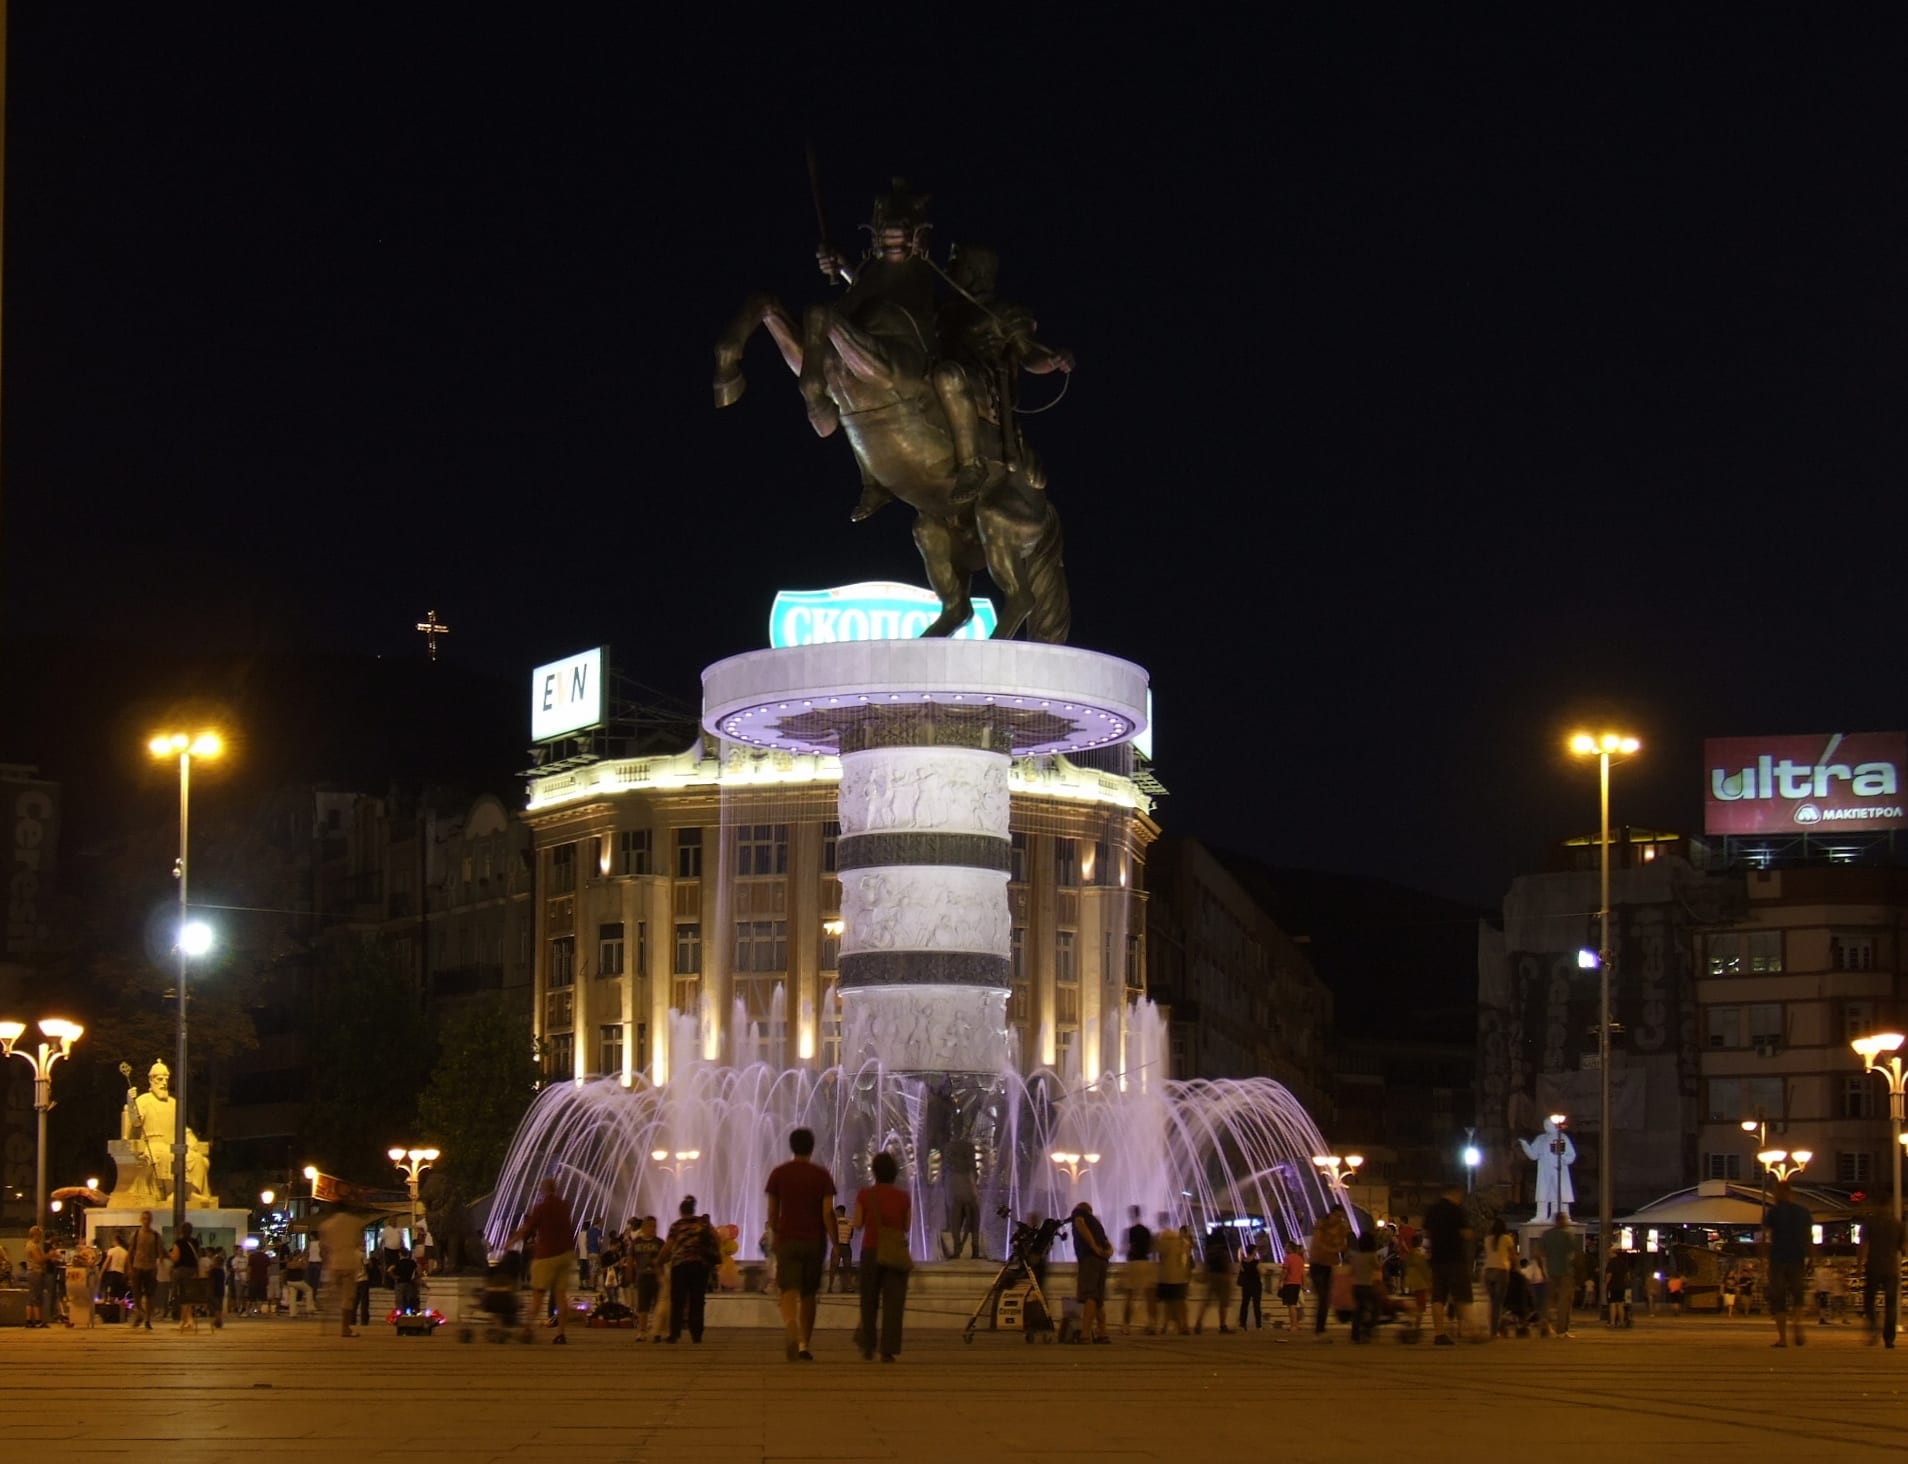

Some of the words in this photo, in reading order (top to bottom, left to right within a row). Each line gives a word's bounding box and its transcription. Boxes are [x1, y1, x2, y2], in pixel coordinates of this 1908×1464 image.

[783, 606, 986, 646] СКОПСО
[1712, 755, 1897, 801] ultra
[1823, 806, 1903, 821] МАКПЕТРОЛ
